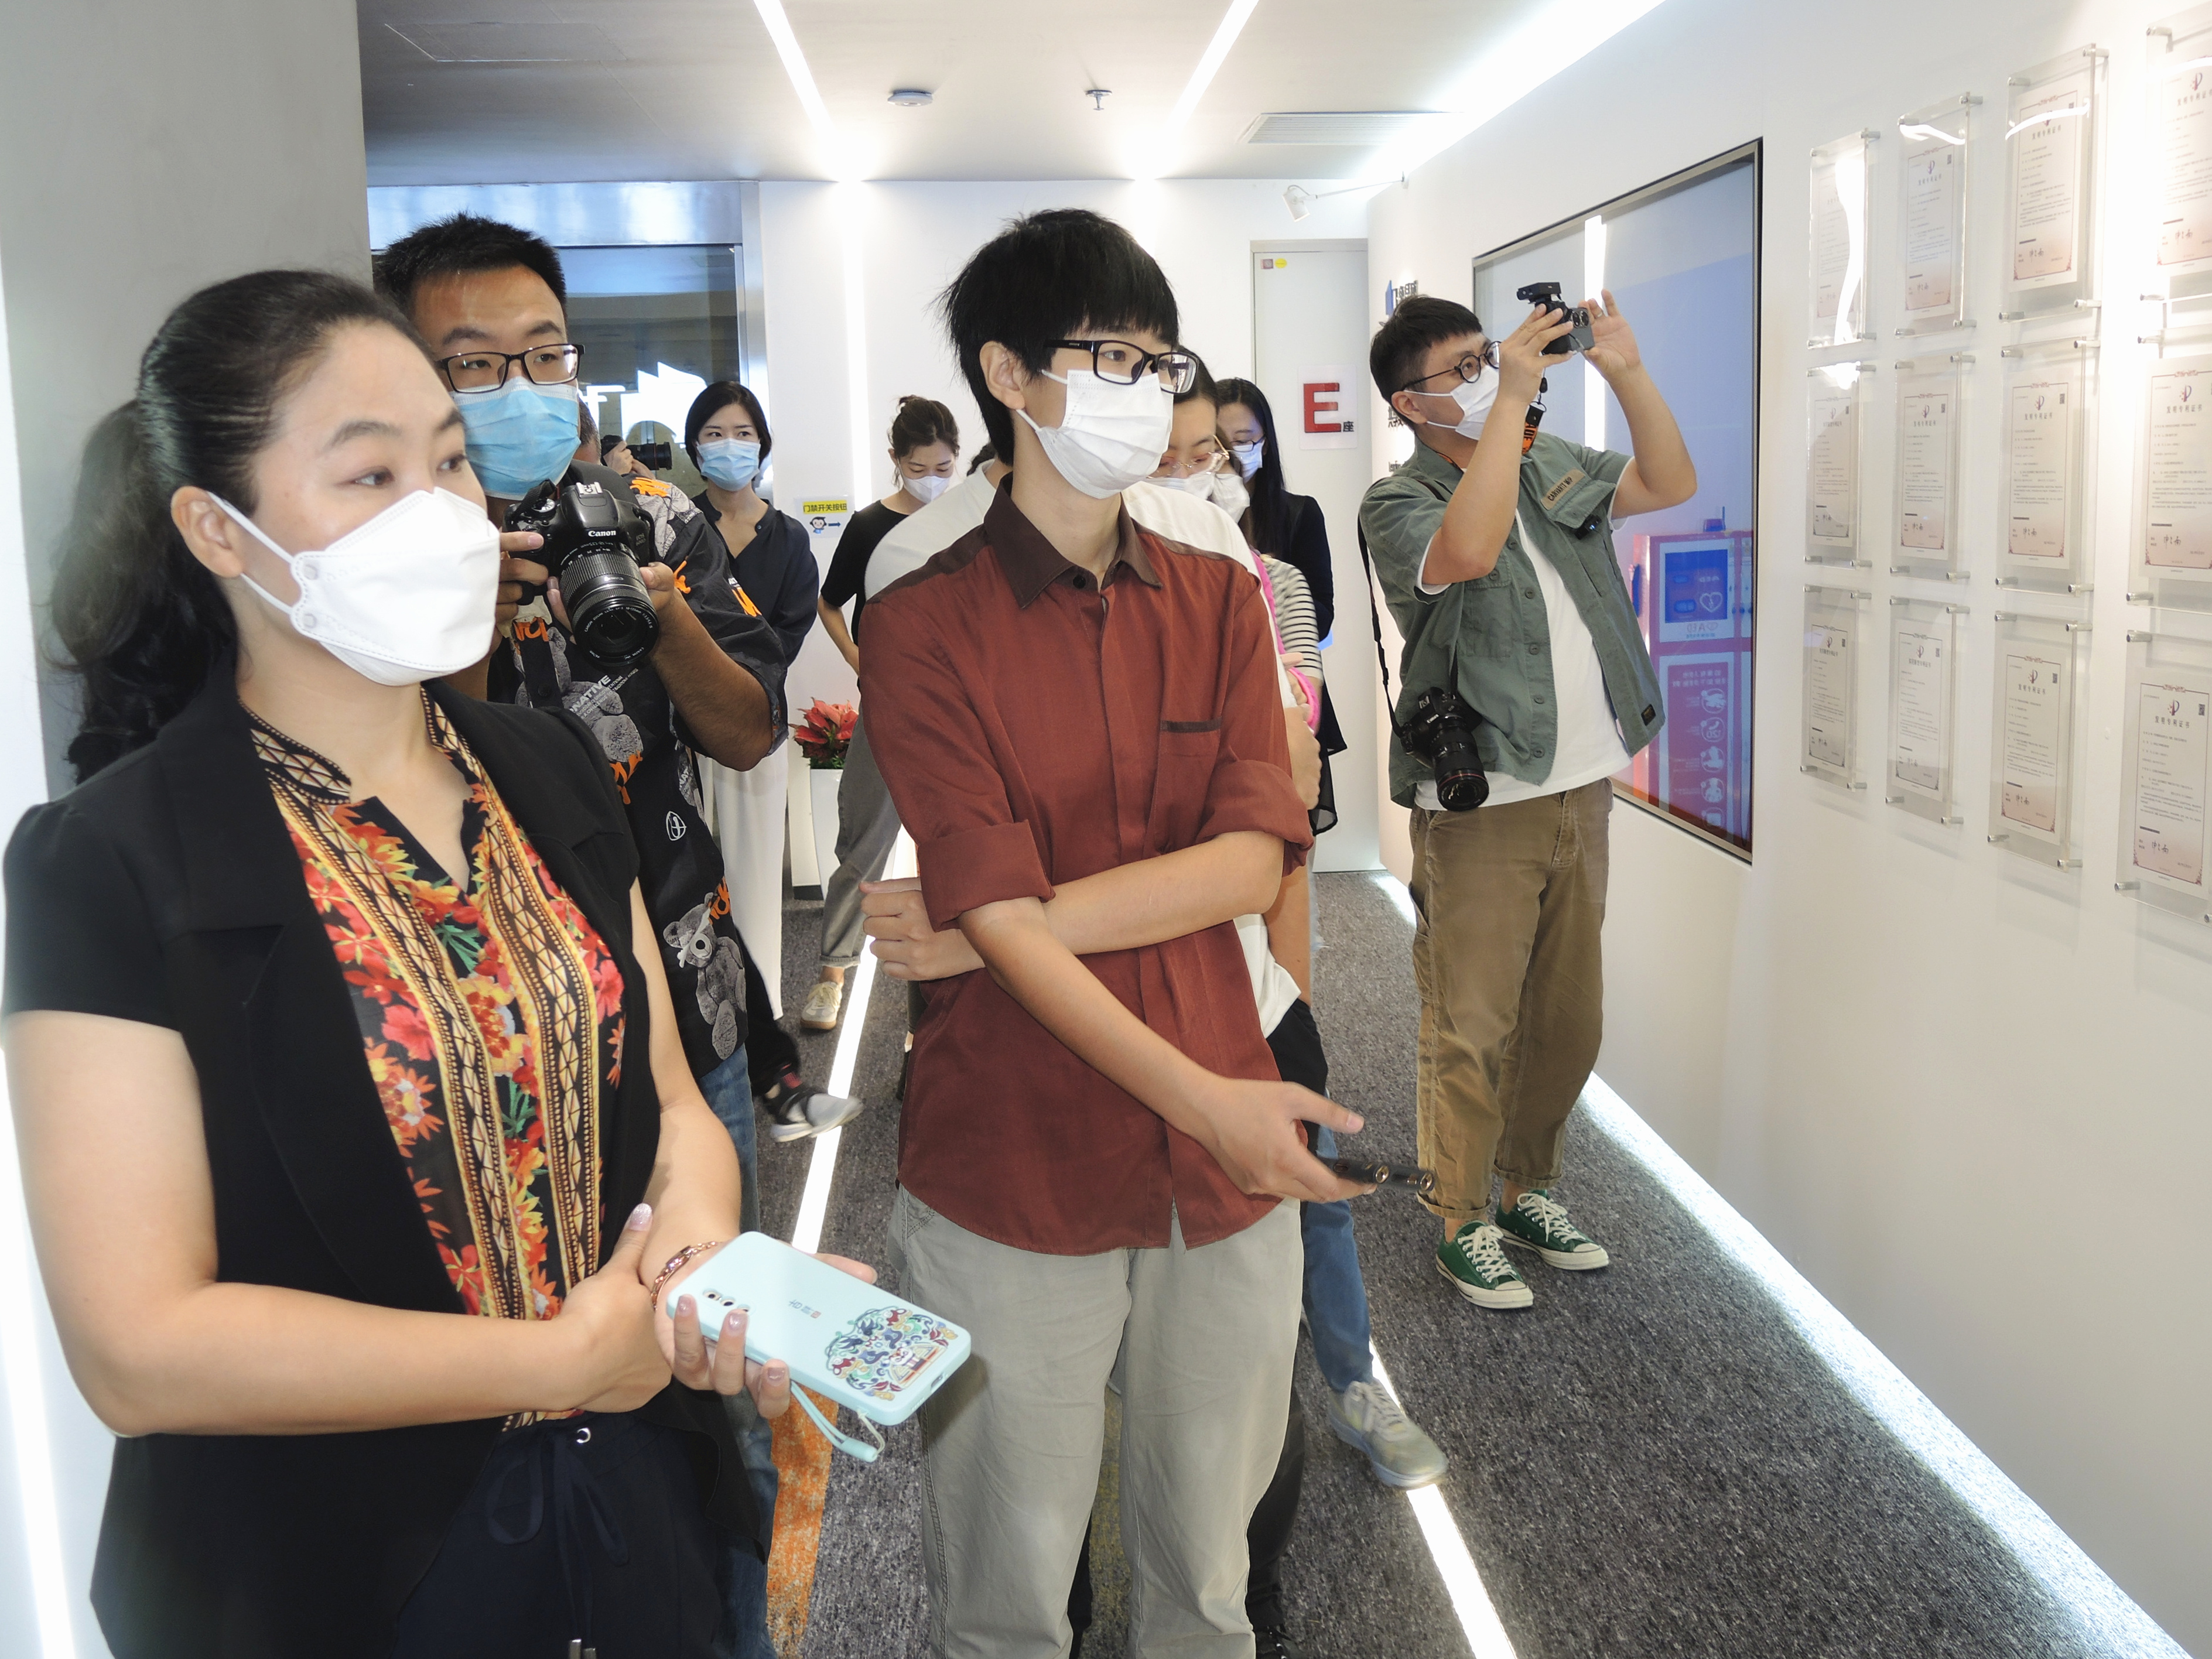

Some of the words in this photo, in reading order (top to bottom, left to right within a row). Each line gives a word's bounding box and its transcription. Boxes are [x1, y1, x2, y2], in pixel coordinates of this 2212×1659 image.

[803, 503, 847, 512] 门禁开关按钮
